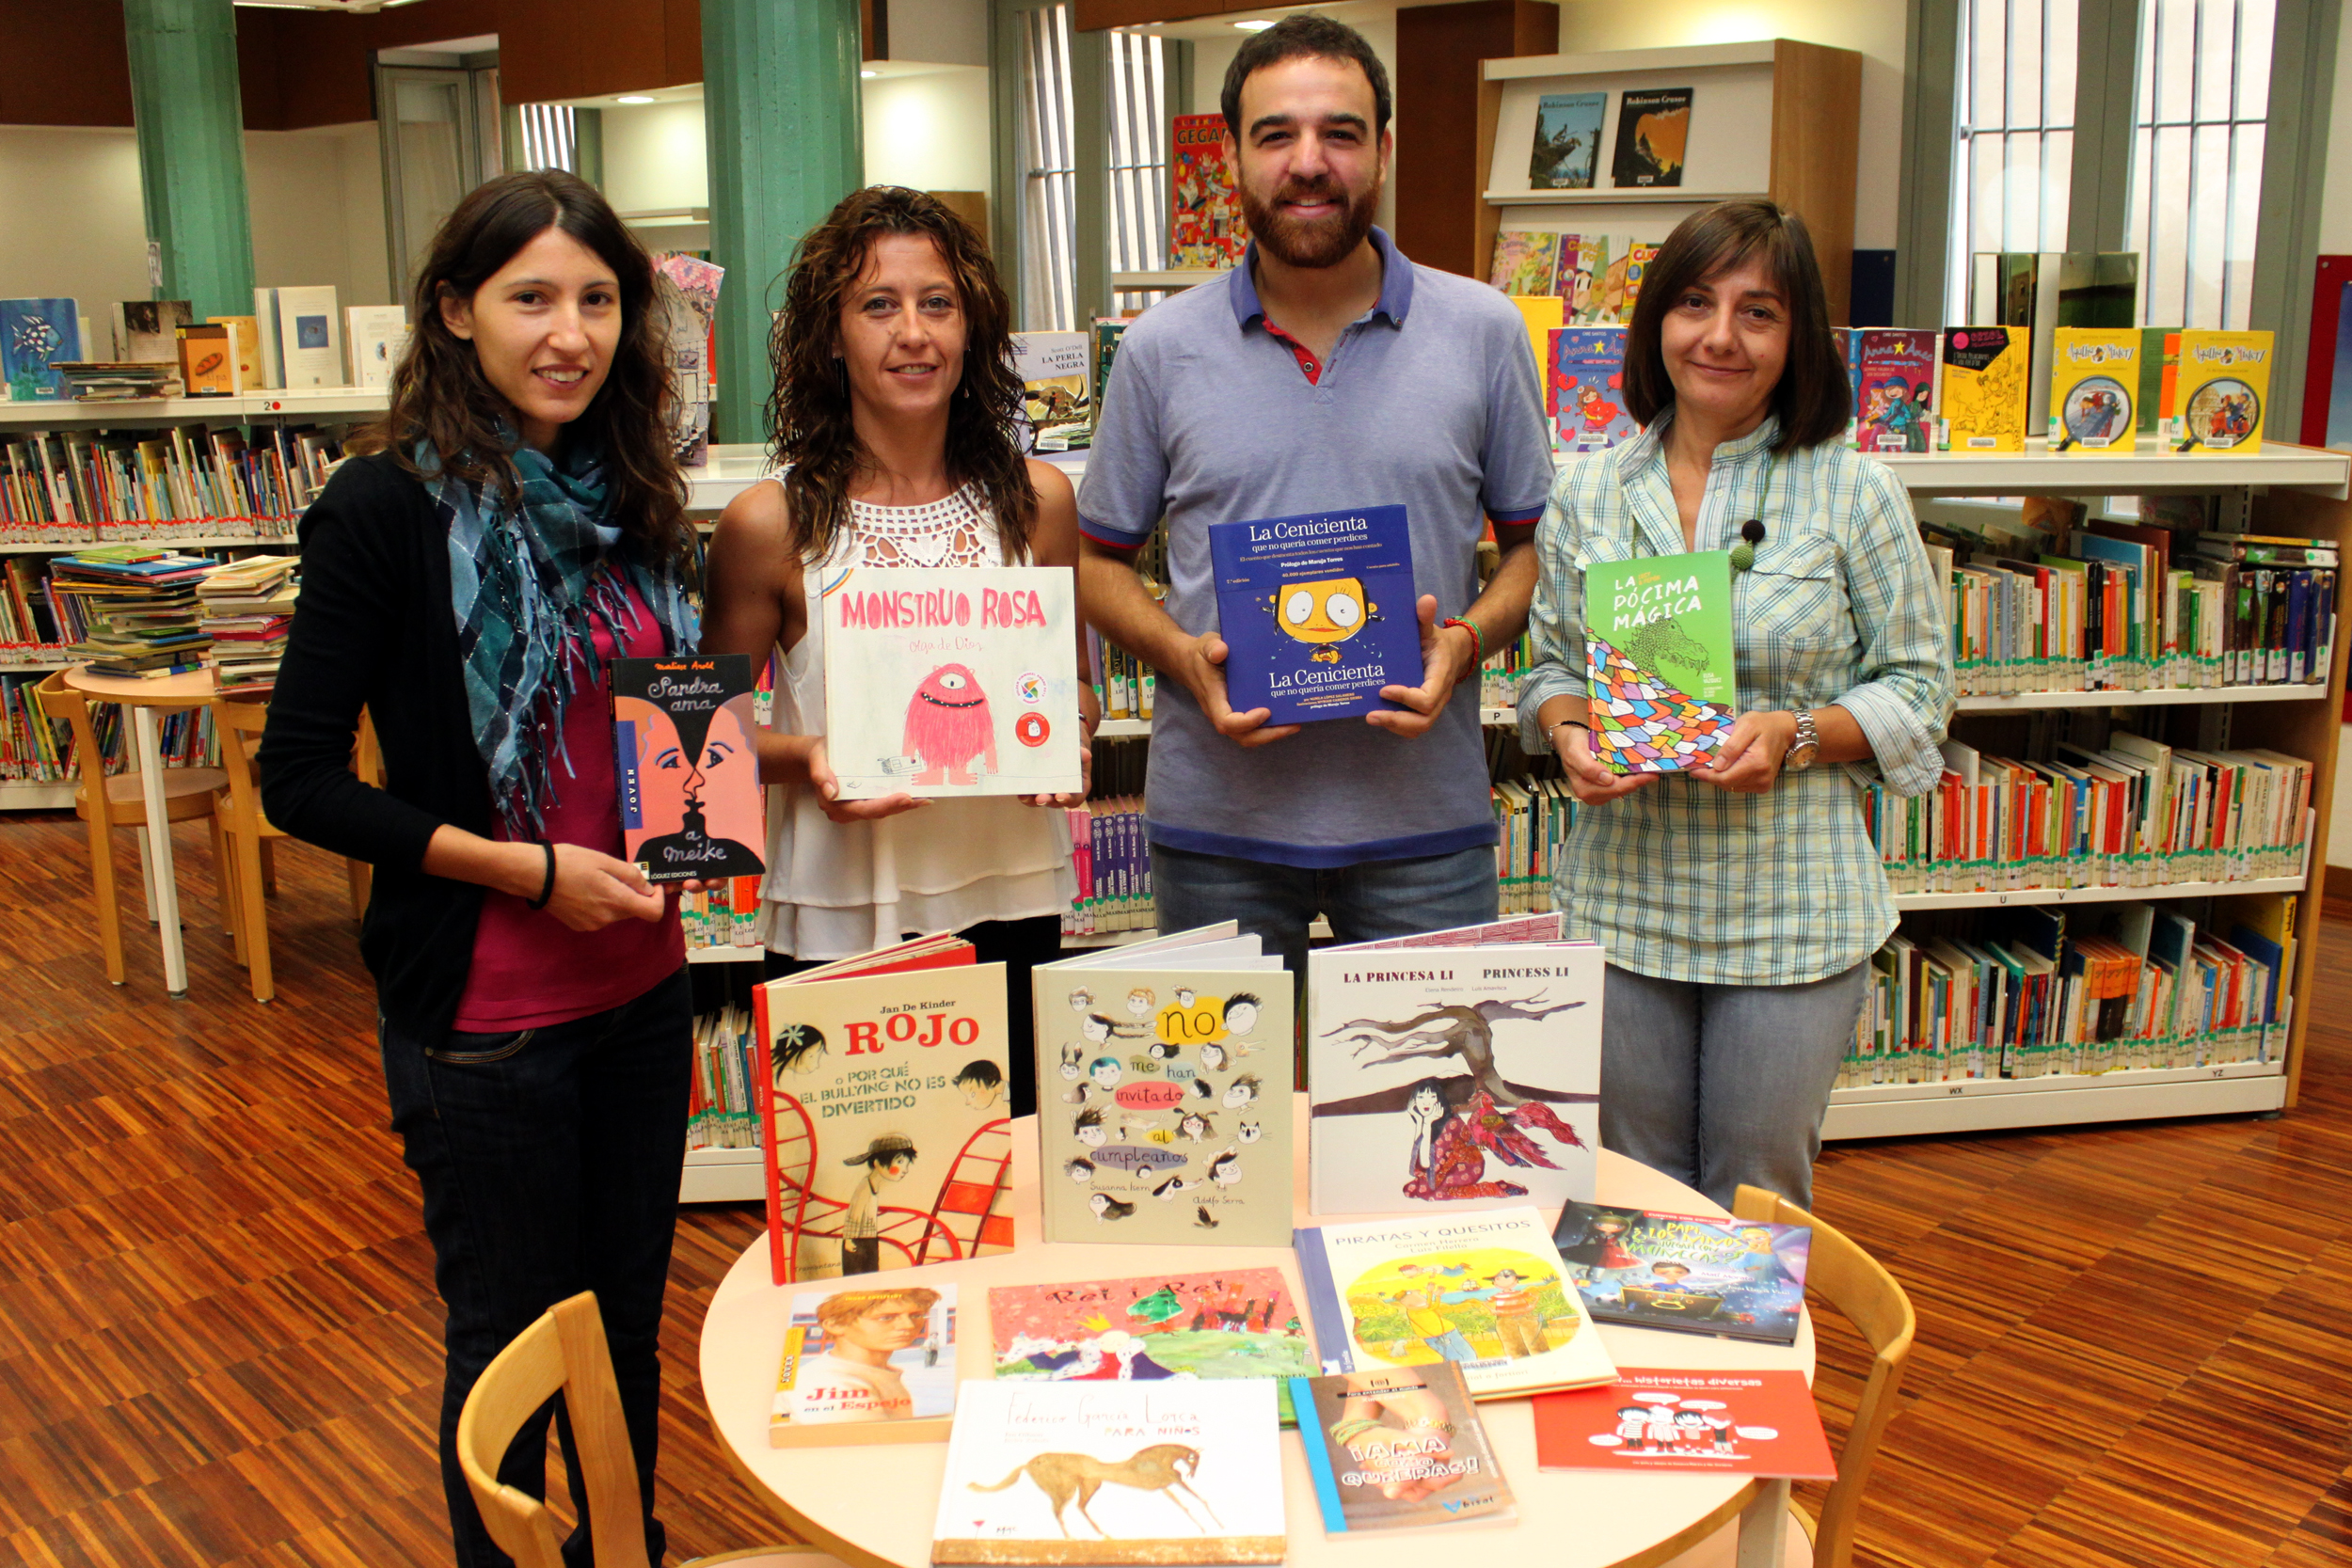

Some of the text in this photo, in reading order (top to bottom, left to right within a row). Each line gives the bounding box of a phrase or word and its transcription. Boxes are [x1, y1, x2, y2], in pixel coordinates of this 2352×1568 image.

[1626, 96, 1660, 105] Robinson
[1056, 352, 1084, 362] PERLA
[1055, 360, 1085, 371] NEGRA
[264, 402, 271, 410] 2
[1249, 516, 1368, 542] La Cenicienta
[1252, 545, 1267, 553] que
[1279, 538, 1306, 552] quería
[1307, 538, 1333, 546] comer
[1333, 532, 1368, 546] perdices
[1280, 560, 1300, 569] Prólogo
[1615, 576, 1636, 591] LA
[1613, 576, 1699, 611] PÓCIMA
[840, 587, 1047, 630] MONSTRUO ROSA
[1613, 595, 1702, 631] MÁGICA
[937, 637, 951, 651] de
[954, 636, 983, 652] Dios
[1269, 663, 1385, 689] La Cenicienta
[648, 676, 723, 698] Sandra
[1271, 689, 1286, 698] que
[1298, 684, 1324, 696] quería
[1325, 682, 1350, 691] comer
[1351, 677, 1386, 689] perdices
[671, 699, 716, 712] ama
[1494, 712, 1501, 721] P
[628, 769, 638, 813] JOVEN
[685, 831, 701, 842] a
[671, 870, 697, 879] EDICIONES
[2000, 895, 2007, 904] U
[1343, 970, 1454, 983] LA PRINCESA LI
[1483, 967, 1569, 979] PRINCESS LI
[880, 999, 956, 1015] Jan De Kinder
[844, 1013, 979, 1056] ROJO
[848, 1061, 909, 1083] POR QUÉ
[1131, 1060, 1154, 1072] me
[1167, 1065, 1197, 1079] han
[800, 1075, 946, 1104] EL BULLYING NO ES
[1116, 1086, 1185, 1102] invitado
[822, 1095, 916, 1118] DIVERTIDO
[1153, 1131, 1169, 1145] al
[1089, 1148, 1189, 1171] cumpleaños
[1089, 1182, 1151, 1192] Susanna Isern
[1193, 1196, 1245, 1207] Adolfo Serra
[1336, 1220, 1532, 1246] PIRATAS Y QUESITOS
[1394, 1235, 1480, 1250] Carmen Herrera
[1410, 1244, 1432, 1254] Luis
[1635, 1376, 1705, 1386] historietas
[1708, 1377, 1762, 1386] diversas
[805, 1387, 870, 1402] Jim
[839, 1398, 911, 1411] Espejo
[1008, 1392, 1200, 1428] Federico García Lorca
[1104, 1427, 1146, 1437] PARA
[1375, 1457, 1434, 1468] COMO
